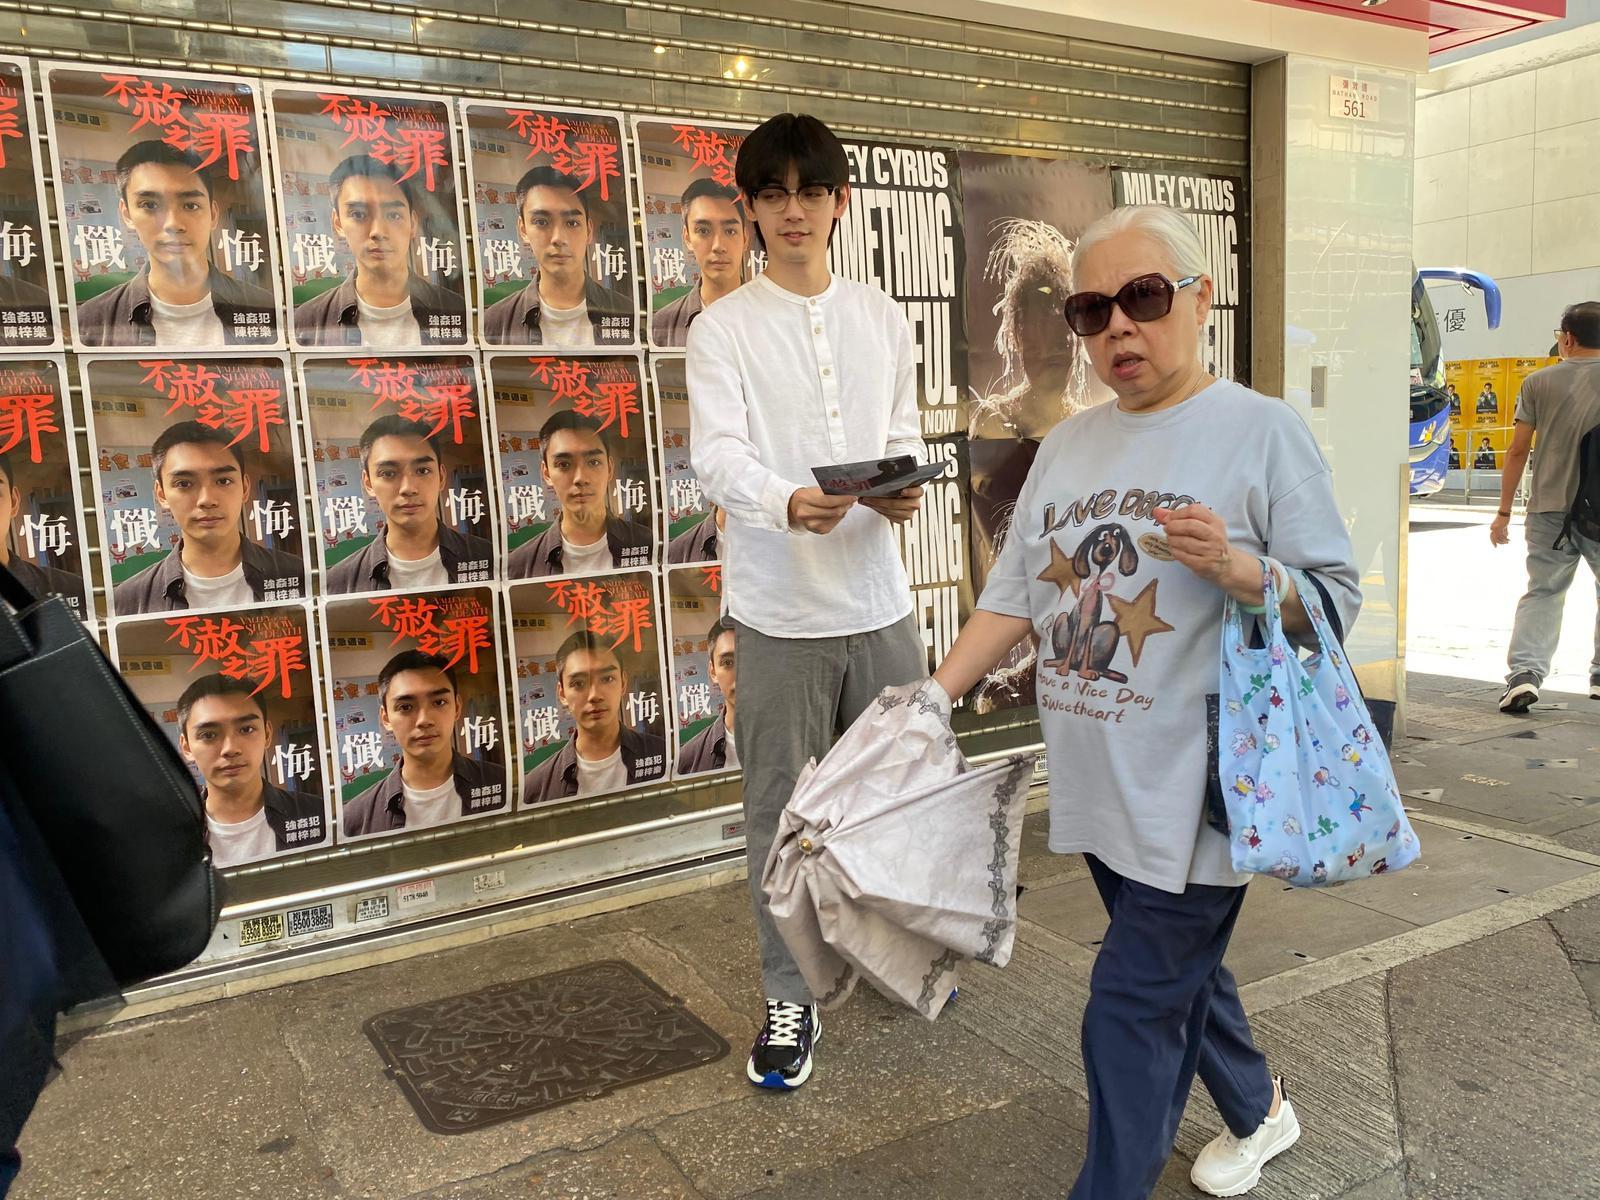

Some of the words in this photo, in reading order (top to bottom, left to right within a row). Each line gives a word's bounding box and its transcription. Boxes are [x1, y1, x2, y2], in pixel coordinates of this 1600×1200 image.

[101, 74, 254, 181] 不赦之罪
[1344, 100, 1365, 118] 561
[317, 93, 449, 192] 不赦之罪
[505, 108, 621, 201] 不赦之罪
[671, 125, 744, 206] 不赦之
[872, 146, 949, 189] CYRUS
[1121, 171, 1176, 208] MILEY
[1178, 176, 1236, 213] CYRUS
[75, 224, 127, 271] 懺
[218, 228, 264, 272] 悔
[293, 233, 337, 275] 懺
[416, 236, 457, 277] 悔
[484, 238, 524, 278] 懺
[592, 243, 628, 281] 悔
[829, 187, 956, 298] METHING
[653, 248, 687, 285] 懺
[1435, 307, 1466, 333] 優
[137, 360, 285, 453] 不赦之罪
[347, 358, 477, 445] 不赦之罪
[528, 357, 640, 439] 不赦之罪
[925, 409, 957, 435] NOW
[324, 495, 369, 537] 懺
[445, 487, 486, 527] 悔
[508, 484, 546, 523] 懺
[613, 478, 647, 515] 悔
[20, 514, 73, 558] 悔
[110, 508, 161, 553] 懺
[249, 500, 295, 541] 悔
[367, 597, 492, 674] 不赦之罪
[544, 580, 653, 653] 不赦之罪
[164, 616, 306, 699] 不赦之罪
[626, 691, 660, 727] 悔
[680, 683, 712, 720] 懺
[1061, 681, 1070, 690] a
[1074, 681, 1108, 698] Nice
[1116, 688, 1155, 711] Day
[461, 716, 499, 754] 悔
[524, 706, 561, 745] 懺
[271, 744, 315, 785] 悔
[342, 731, 385, 773] 懺
